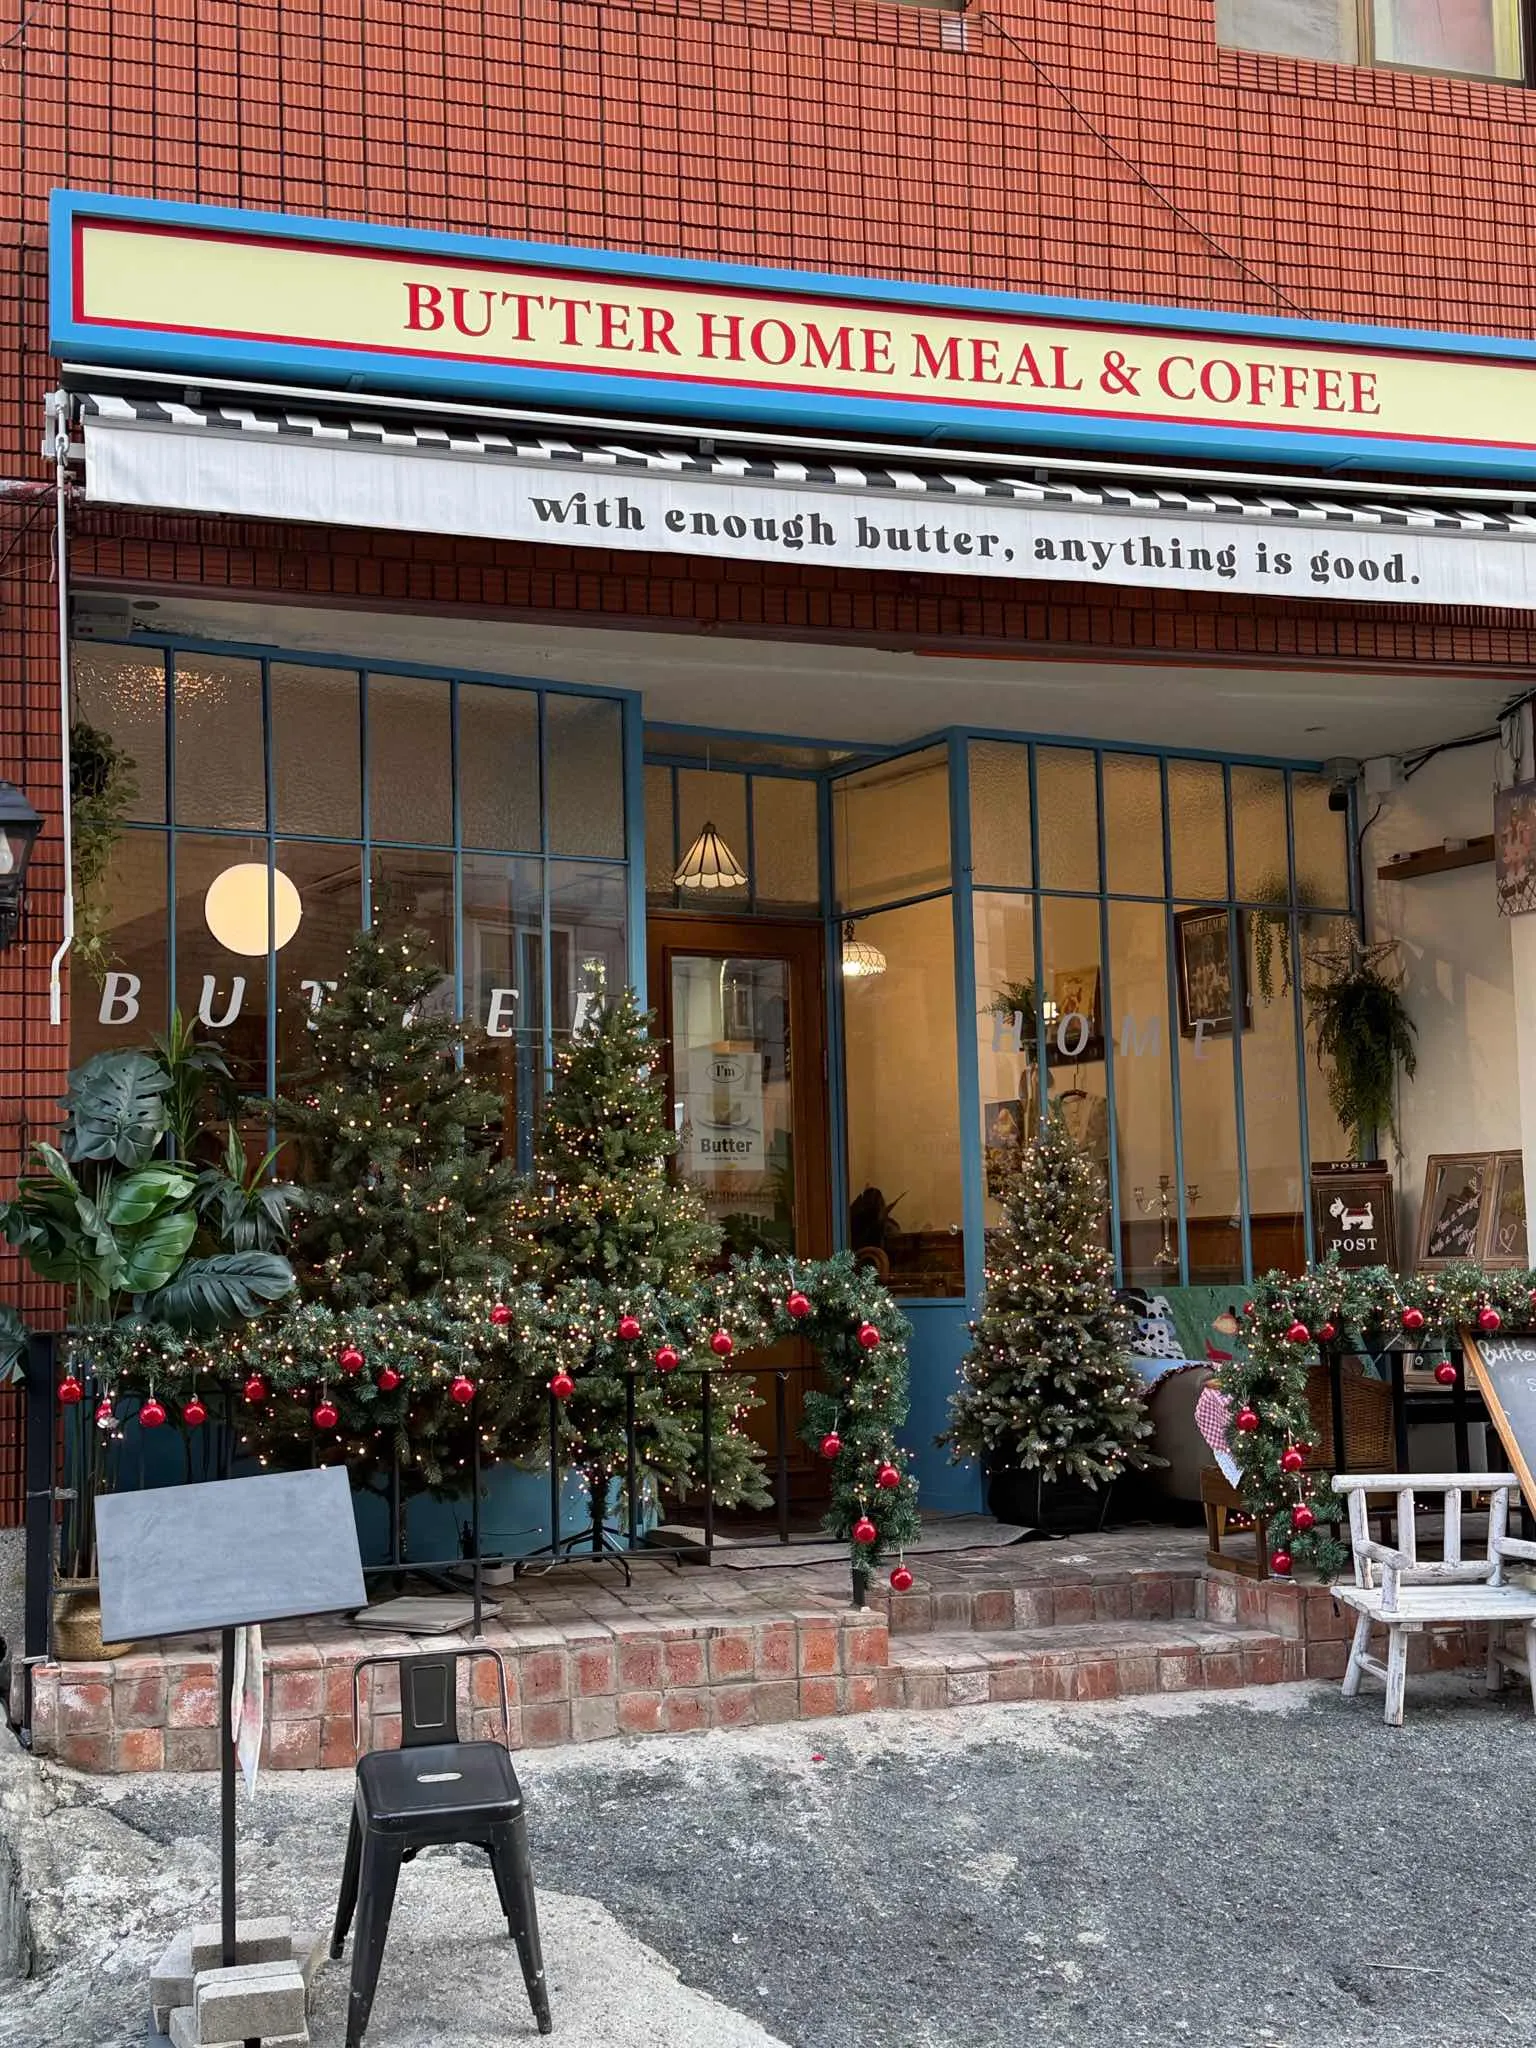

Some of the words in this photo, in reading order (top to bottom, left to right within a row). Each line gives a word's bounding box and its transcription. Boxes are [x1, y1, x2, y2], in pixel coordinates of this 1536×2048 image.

[403, 282, 682, 356] BUTTER
[696, 312, 896, 375] HOME
[911, 333, 1083, 391] MEAL
[1099, 350, 1142, 396] &
[1158, 356, 1381, 415] COFFEE
[528, 492, 645, 531] with
[664, 509, 837, 551] enough
[855, 516, 1014, 562] butter,
[1034, 535, 1237, 579] anything
[1255, 542, 1292, 575] is
[1310, 553, 1420, 586] good.
[98, 971, 606, 1040] BUTER
[700, 1138, 753, 1153] Butter
[1330, 1161, 1369, 1170] POST
[1331, 1237, 1378, 1252] POST
